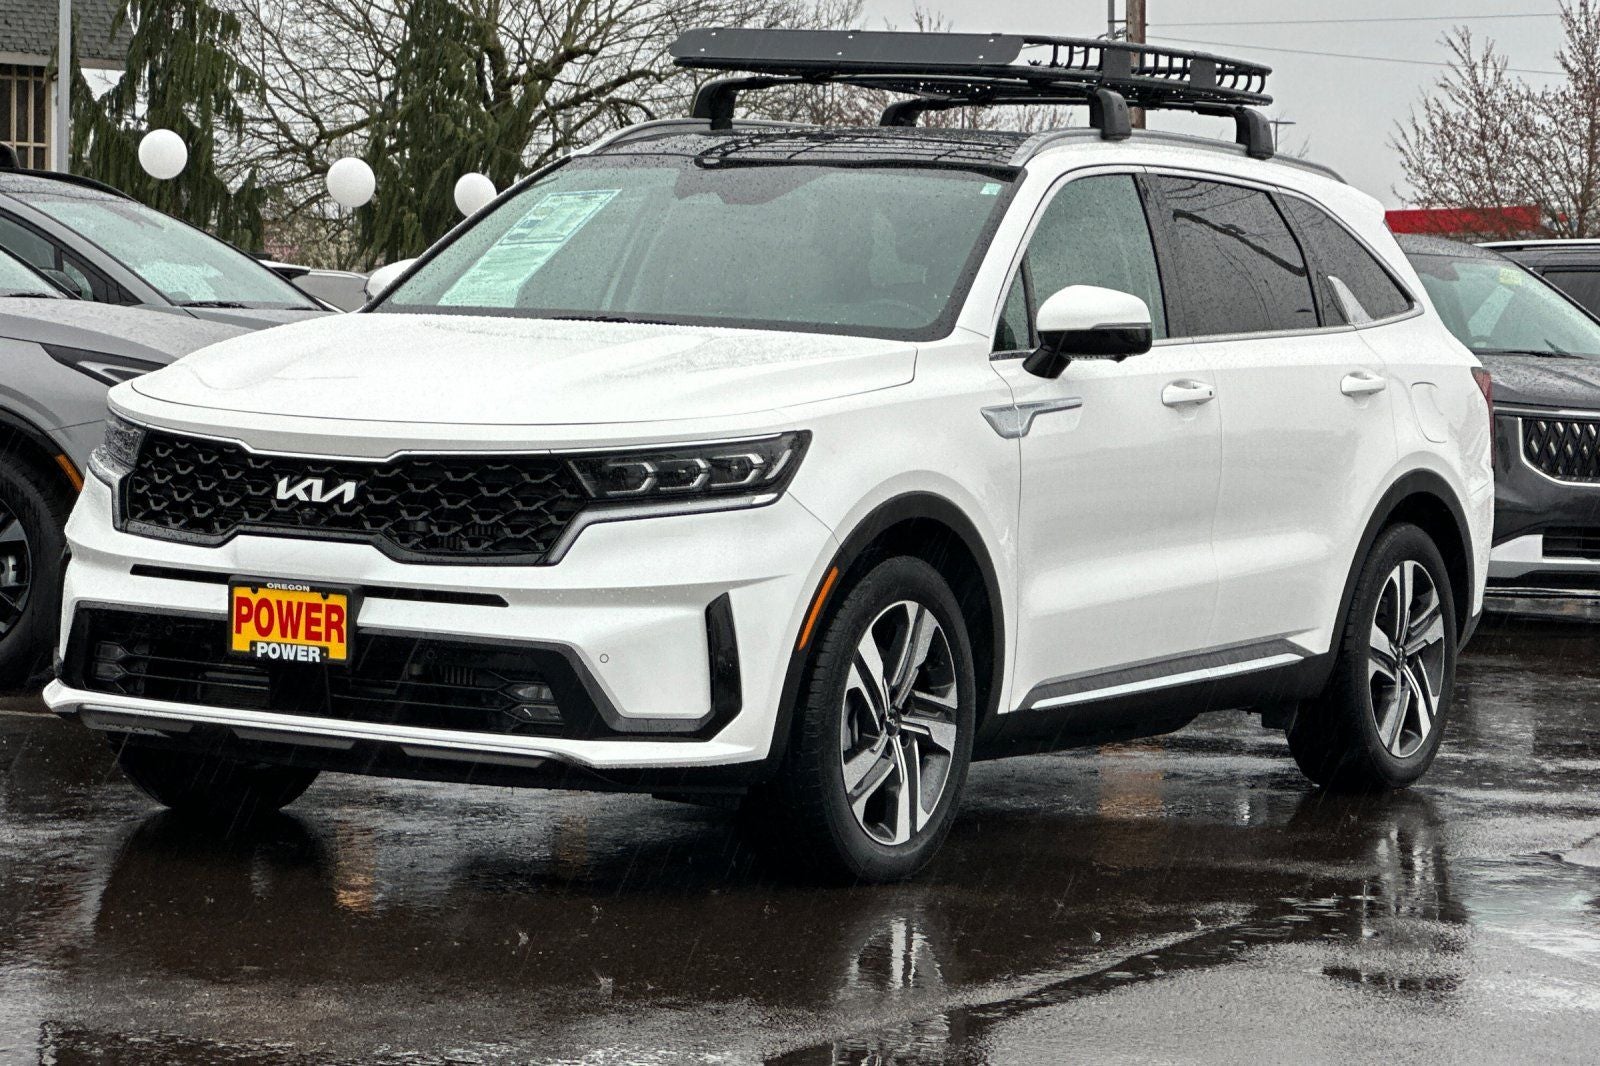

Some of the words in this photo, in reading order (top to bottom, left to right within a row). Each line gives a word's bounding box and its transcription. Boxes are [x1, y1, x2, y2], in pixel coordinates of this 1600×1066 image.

[276, 476, 357, 504] KIA
[266, 582, 310, 592] OREGON
[235, 596, 345, 644] POWER
[256, 642, 321, 663] POWER
